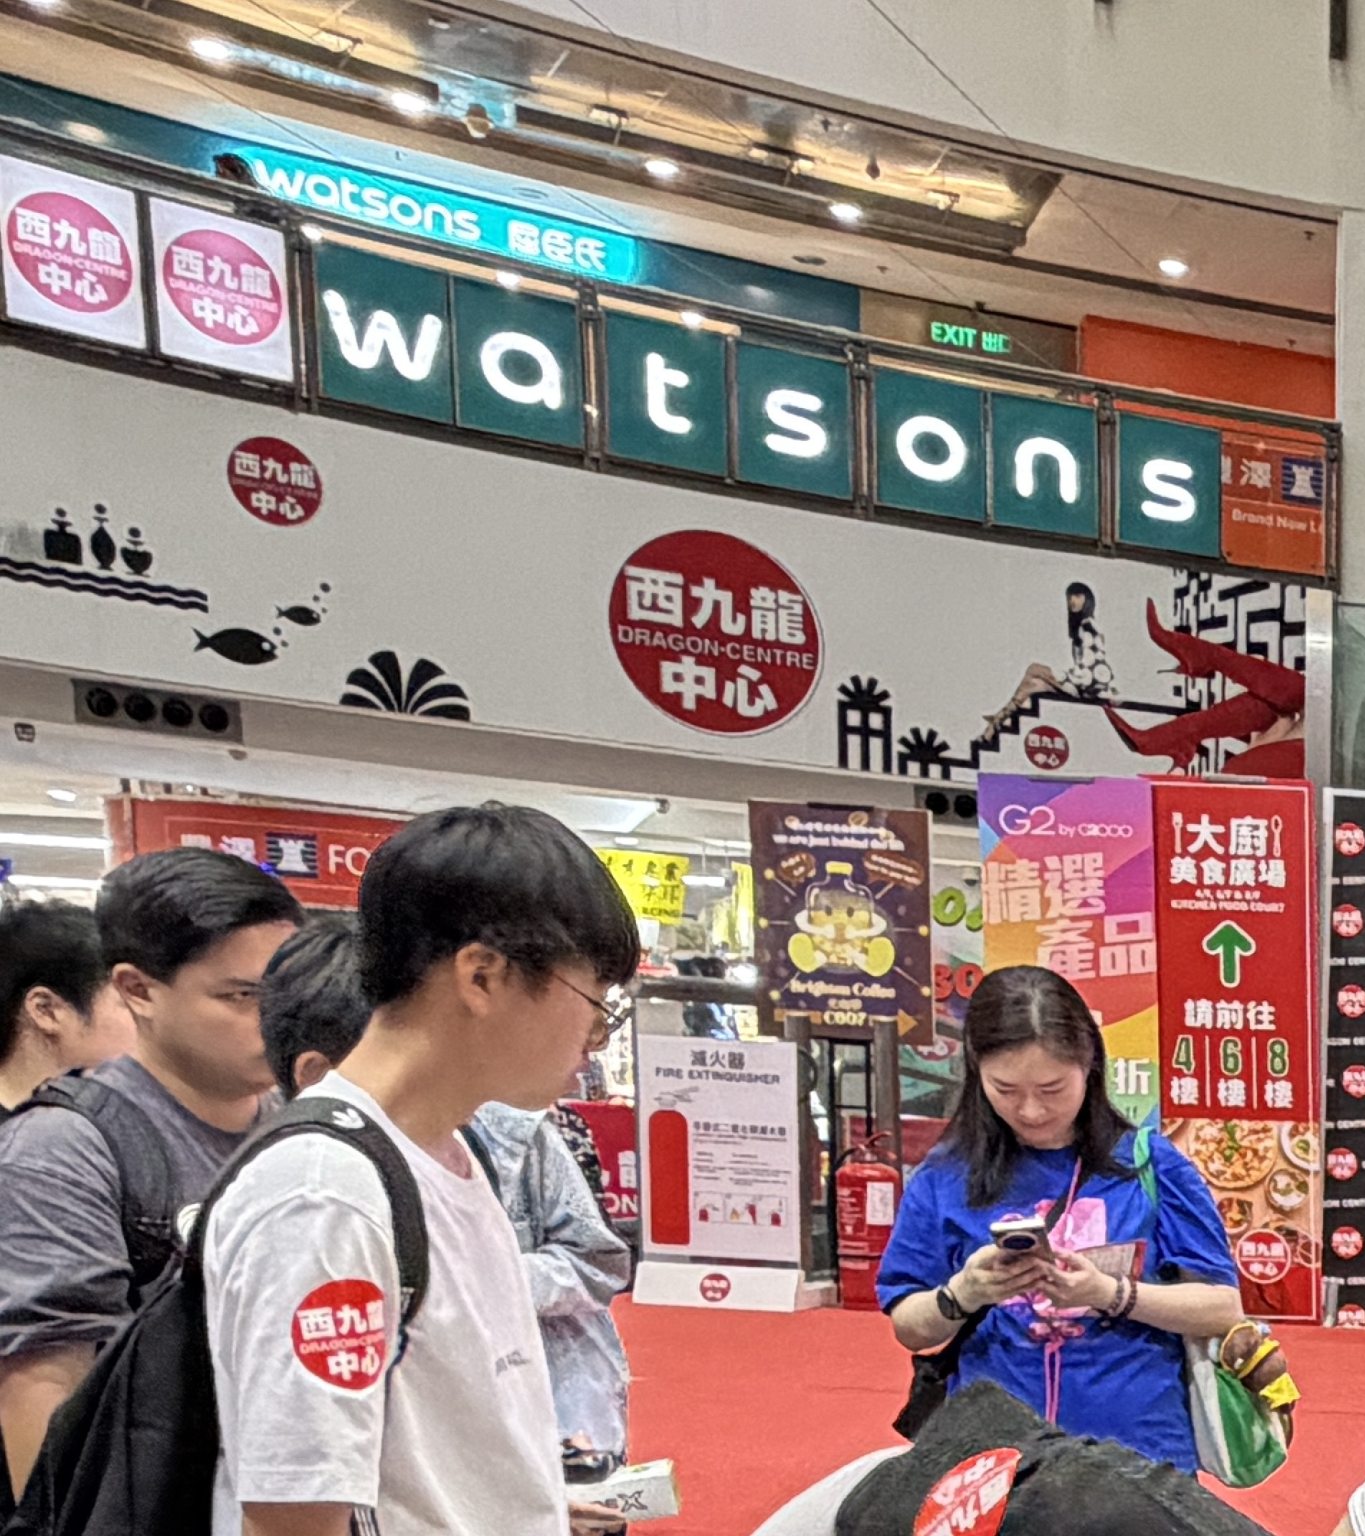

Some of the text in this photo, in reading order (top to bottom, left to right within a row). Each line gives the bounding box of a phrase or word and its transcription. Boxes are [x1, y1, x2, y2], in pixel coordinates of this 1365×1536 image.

[15, 207, 124, 266] 西九龍
[253, 160, 607, 272] watsons 屈臣氏
[38, 263, 108, 304] 中心
[171, 246, 275, 299] 西九龍
[192, 298, 260, 336] 中心
[930, 321, 977, 348] EXIT
[322, 288, 1197, 522] watsons
[235, 450, 317, 490] 西九龍
[251, 490, 305, 520] 中心
[624, 564, 807, 646] 西九龍
[659, 655, 779, 717] 中心
[999, 804, 1056, 836] G2
[1058, 823, 1076, 838] by
[1186, 813, 1269, 858] 大廚
[983, 851, 1107, 925] 精選
[1169, 857, 1287, 889] 美食廣場
[1184, 998, 1276, 1031] 請前往
[655, 1066, 684, 1081] FIRE
[1172, 1034, 1290, 1077] 4 6 8
